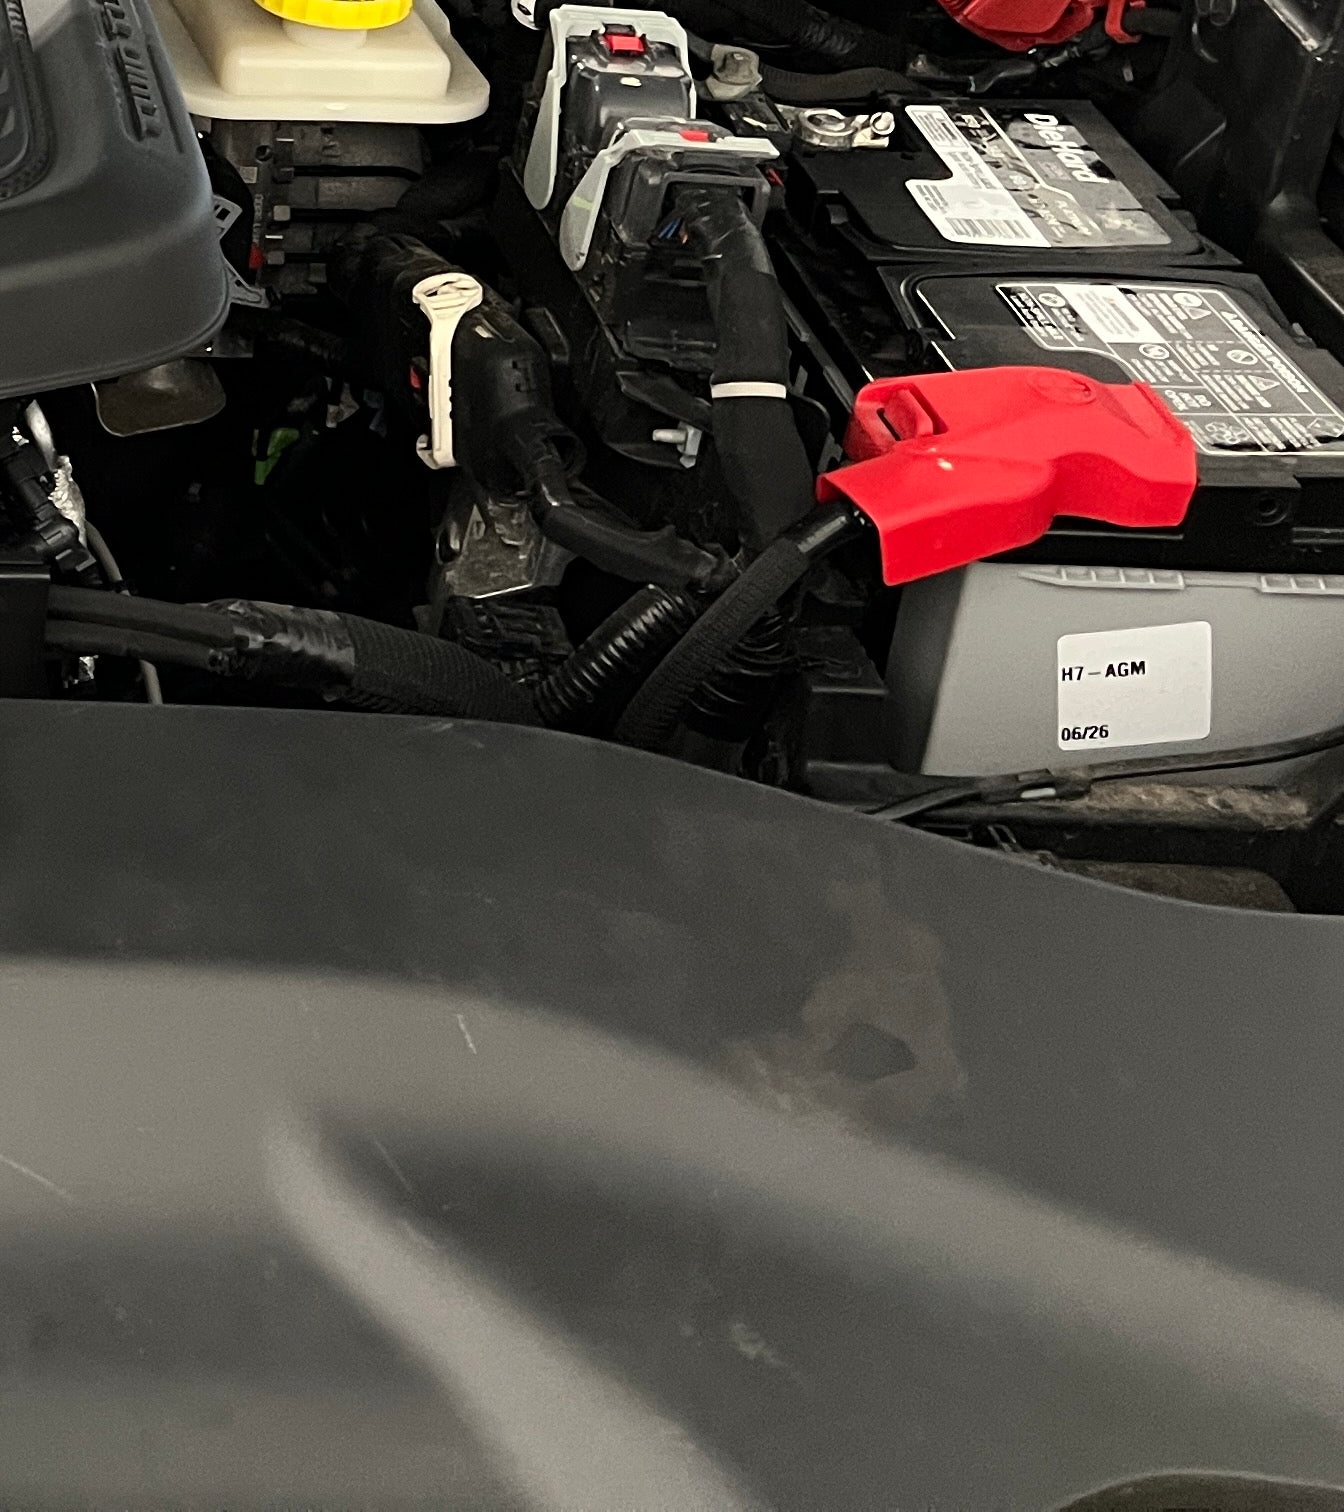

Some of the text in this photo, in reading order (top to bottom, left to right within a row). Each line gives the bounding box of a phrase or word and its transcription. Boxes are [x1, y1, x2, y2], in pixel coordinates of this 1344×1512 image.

[1023, 112, 1110, 184] DieHard
[1061, 666, 1084, 682] H7
[1104, 660, 1146, 678] AGM
[1061, 724, 1109, 742] 06/26
